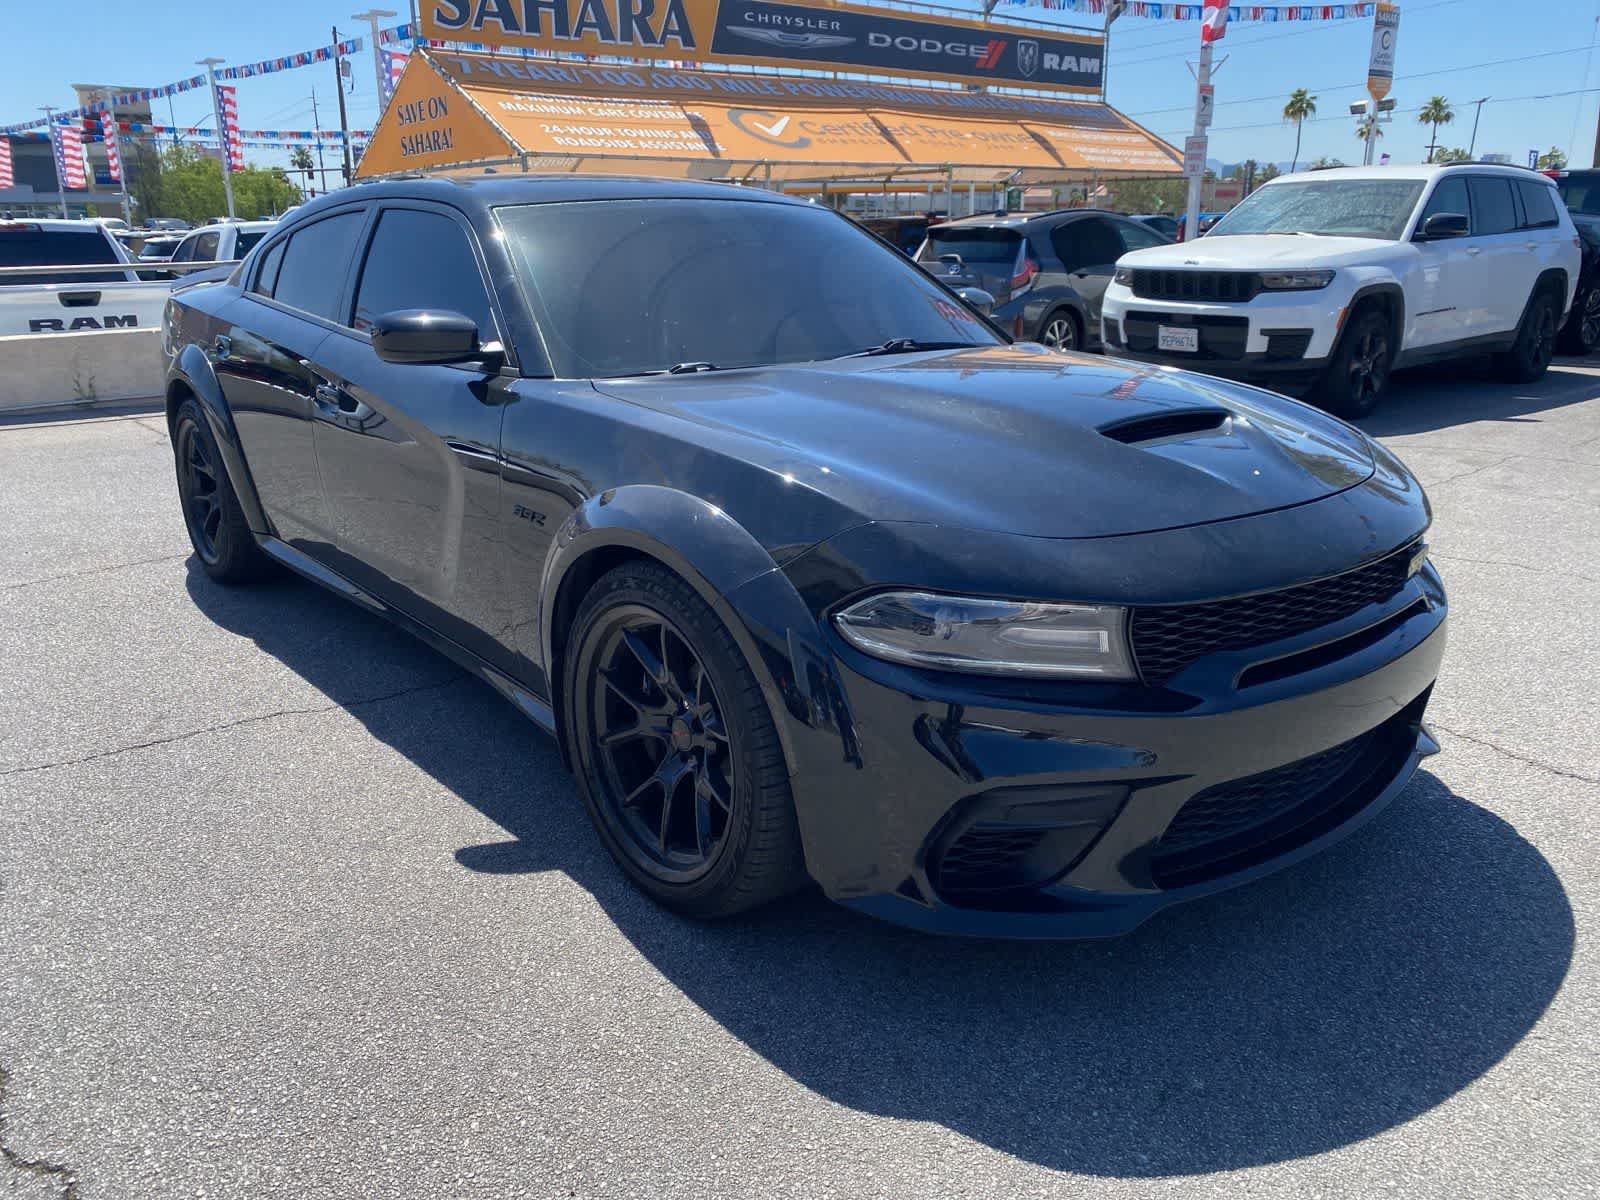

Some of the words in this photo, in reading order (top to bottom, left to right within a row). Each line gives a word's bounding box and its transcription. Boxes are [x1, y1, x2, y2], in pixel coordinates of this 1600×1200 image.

[432, 0, 697, 50] SAHARA
[743, 11, 841, 31] CHRYSLER
[867, 32, 990, 58] DODGE
[1042, 52, 1101, 75] RAM
[712, 76, 785, 97] MILE
[397, 99, 427, 127] SAVE
[427, 96, 449, 121] ON
[497, 101, 586, 117] MAXIMUM
[586, 105, 633, 119] CARE
[539, 123, 614, 139] 24-HOUR
[616, 127, 677, 140] TOWING
[400, 129, 454, 158] SAHARA!
[552, 135, 638, 150] ROADSIDE
[28, 315, 138, 332] RAM
